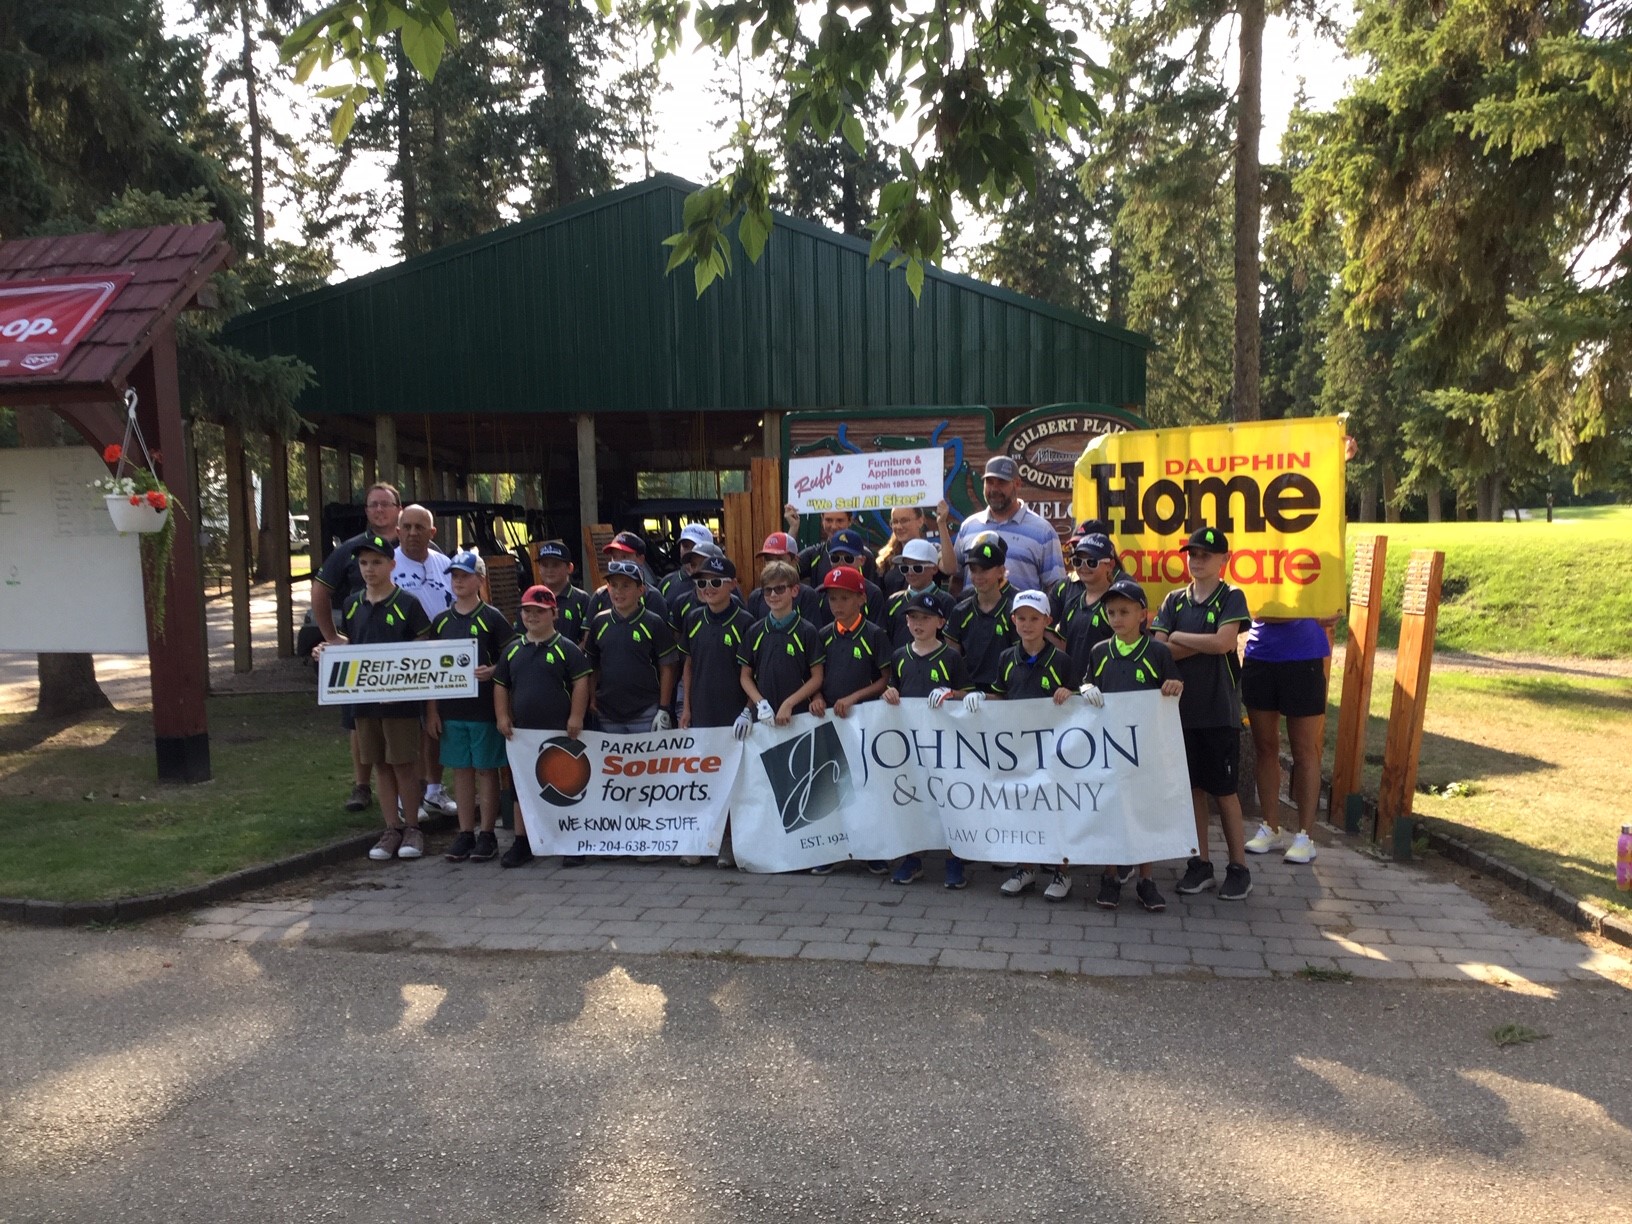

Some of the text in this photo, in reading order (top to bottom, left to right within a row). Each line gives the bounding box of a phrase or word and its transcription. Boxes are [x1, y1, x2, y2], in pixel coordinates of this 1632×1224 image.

[1013, 418, 1078, 452] GILBERT
[868, 455, 922, 468] Furniture &
[1166, 452, 1311, 476] DAUPHIN
[794, 459, 844, 498] Ruff's
[868, 466, 921, 480] Appliances
[861, 482, 891, 491] Dauphin
[910, 479, 927, 488] LTD.
[835, 497, 860, 510] Sell
[863, 495, 879, 508] All
[1091, 461, 1321, 535] Home
[1119, 539, 1321, 585] ardare
[359, 658, 432, 673] REIT-SYD
[356, 671, 467, 687] EQUIPMENT LTD.
[601, 737, 695, 754] PARKLAND
[860, 724, 1140, 787] JOHNSTON
[601, 755, 722, 777] Source
[602, 779, 711, 807] for sports.
[892, 774, 1105, 813] & COMPANY
[559, 816, 700, 831] WE KNOW OUR STUFF.
[800, 834, 825, 850] EST.
[948, 827, 1046, 845] LAW OFFICE
[577, 840, 678, 852] Ph: 204-638-7057
